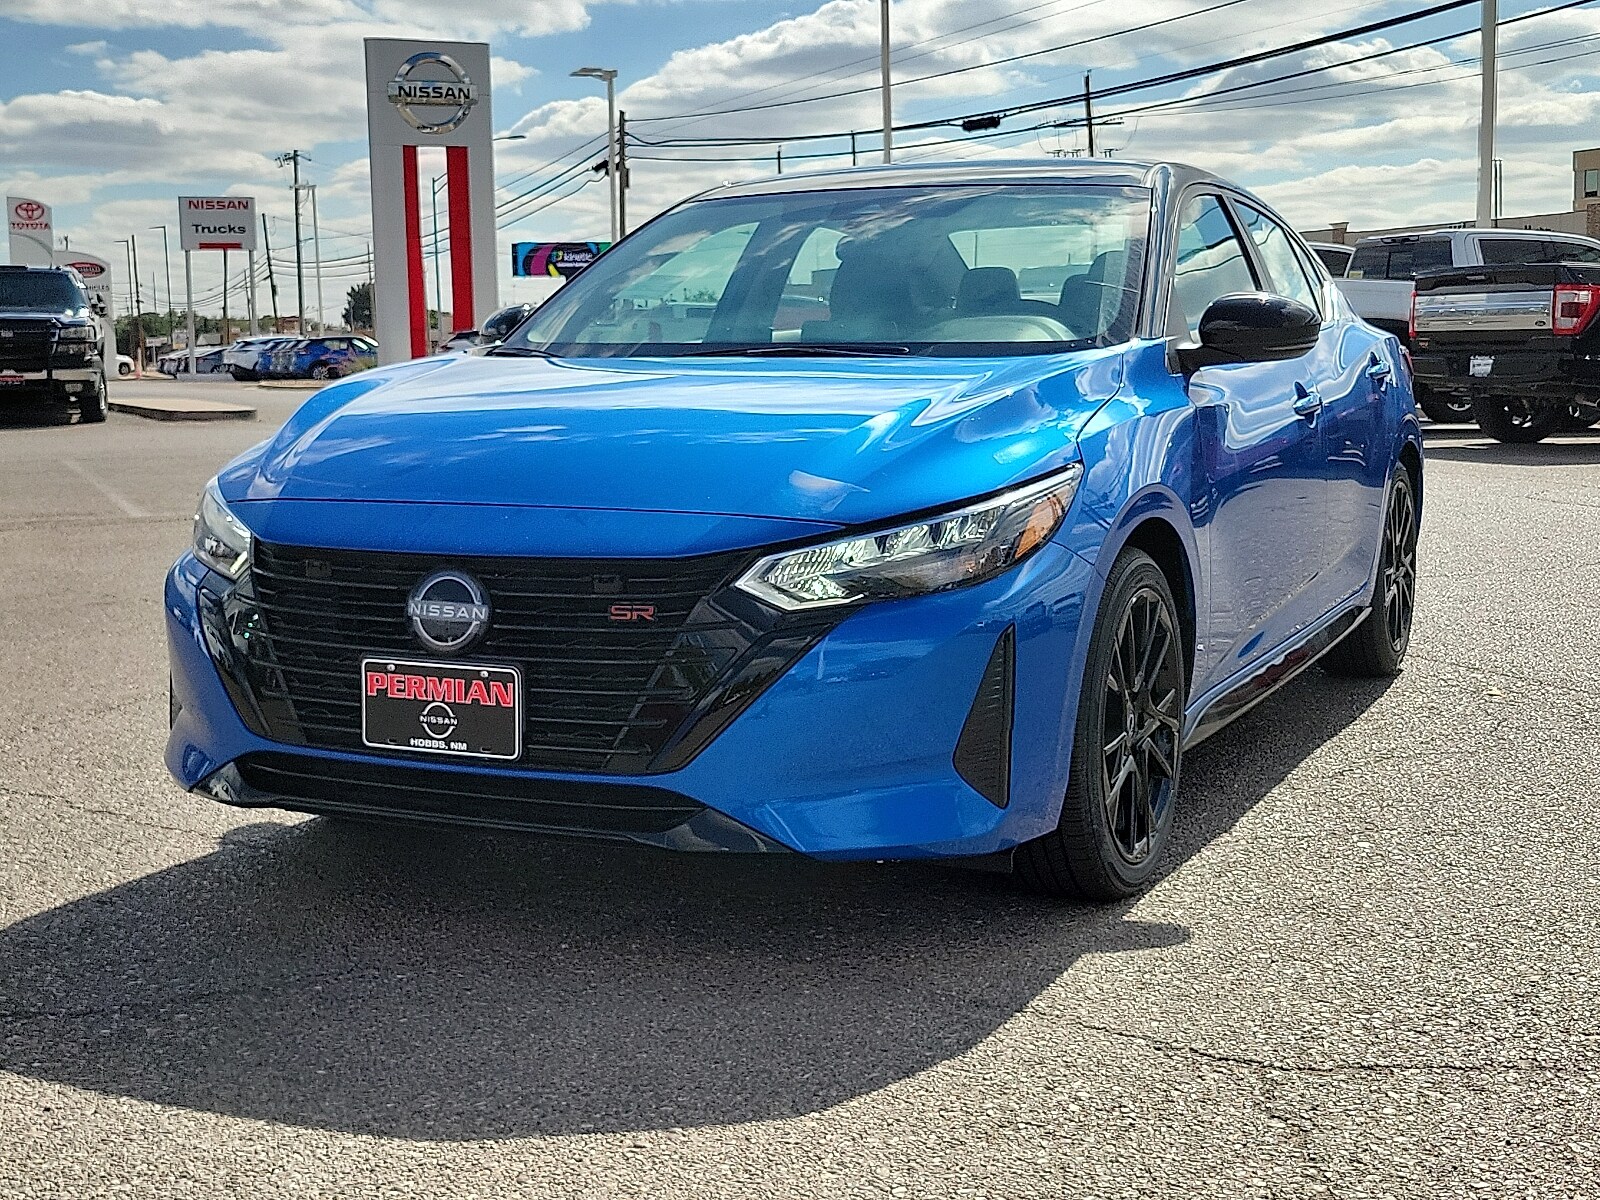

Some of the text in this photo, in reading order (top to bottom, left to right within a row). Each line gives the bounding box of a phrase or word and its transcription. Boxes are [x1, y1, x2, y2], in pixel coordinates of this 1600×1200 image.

[397, 86, 471, 99] NISSAN
[188, 200, 249, 210] NISSAN
[11, 222, 51, 230] TOYOTA
[192, 223, 247, 234] Trucks
[408, 602, 487, 620] NISSAN
[609, 606, 654, 620] SR
[366, 672, 514, 707] PERMIAN
[419, 715, 458, 725] NISSAN
[410, 738, 467, 750] HOBBS, NM
